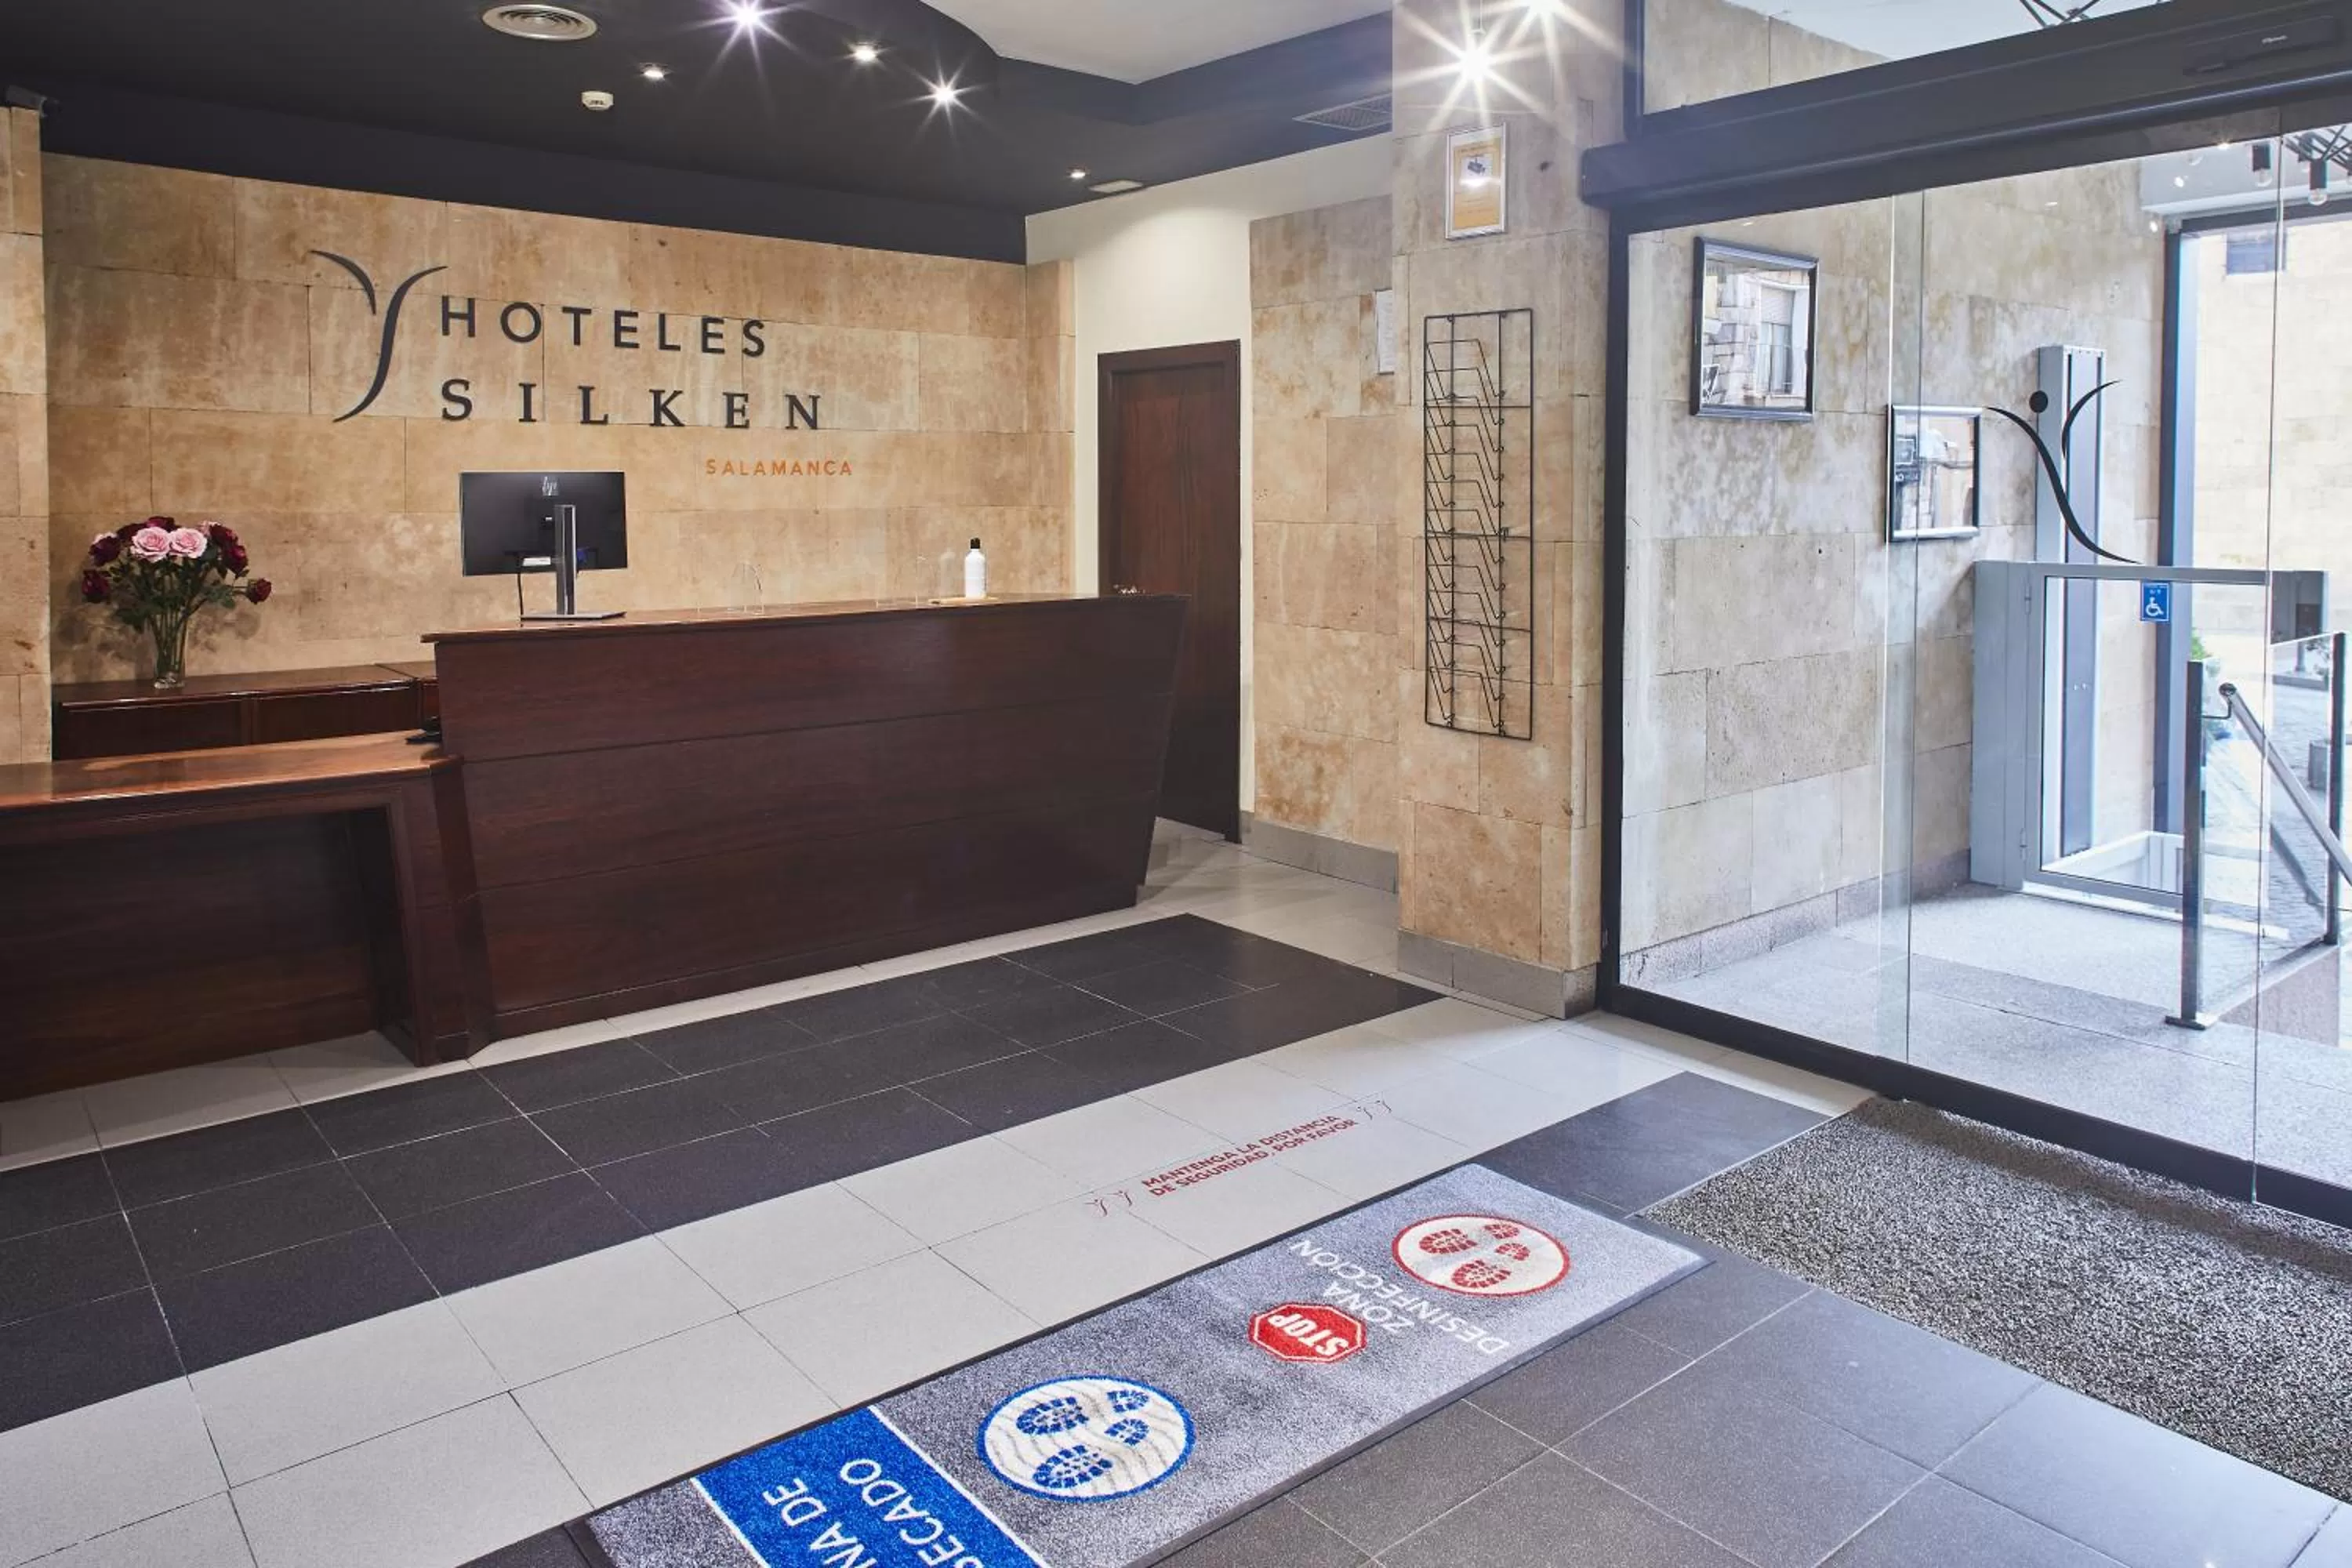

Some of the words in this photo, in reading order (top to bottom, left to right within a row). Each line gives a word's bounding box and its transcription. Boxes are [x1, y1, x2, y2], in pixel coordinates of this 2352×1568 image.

[441, 295, 765, 358] HOTELES
[441, 378, 821, 430] SILKEN
[706, 458, 853, 477] SALAMANCA
[1142, 1151, 1238, 1188] MANTENGA
[1236, 1142, 1261, 1153] LA
[1258, 1115, 1341, 1145] DISTANCIA
[1149, 1183, 1176, 1196] DE
[1272, 1137, 1309, 1152] POR
[1305, 1119, 1359, 1141] FAVOR
[1323, 1280, 1415, 1334] ZONA
[1267, 1312, 1349, 1356] STOP
[762, 1477, 828, 1527] DE
